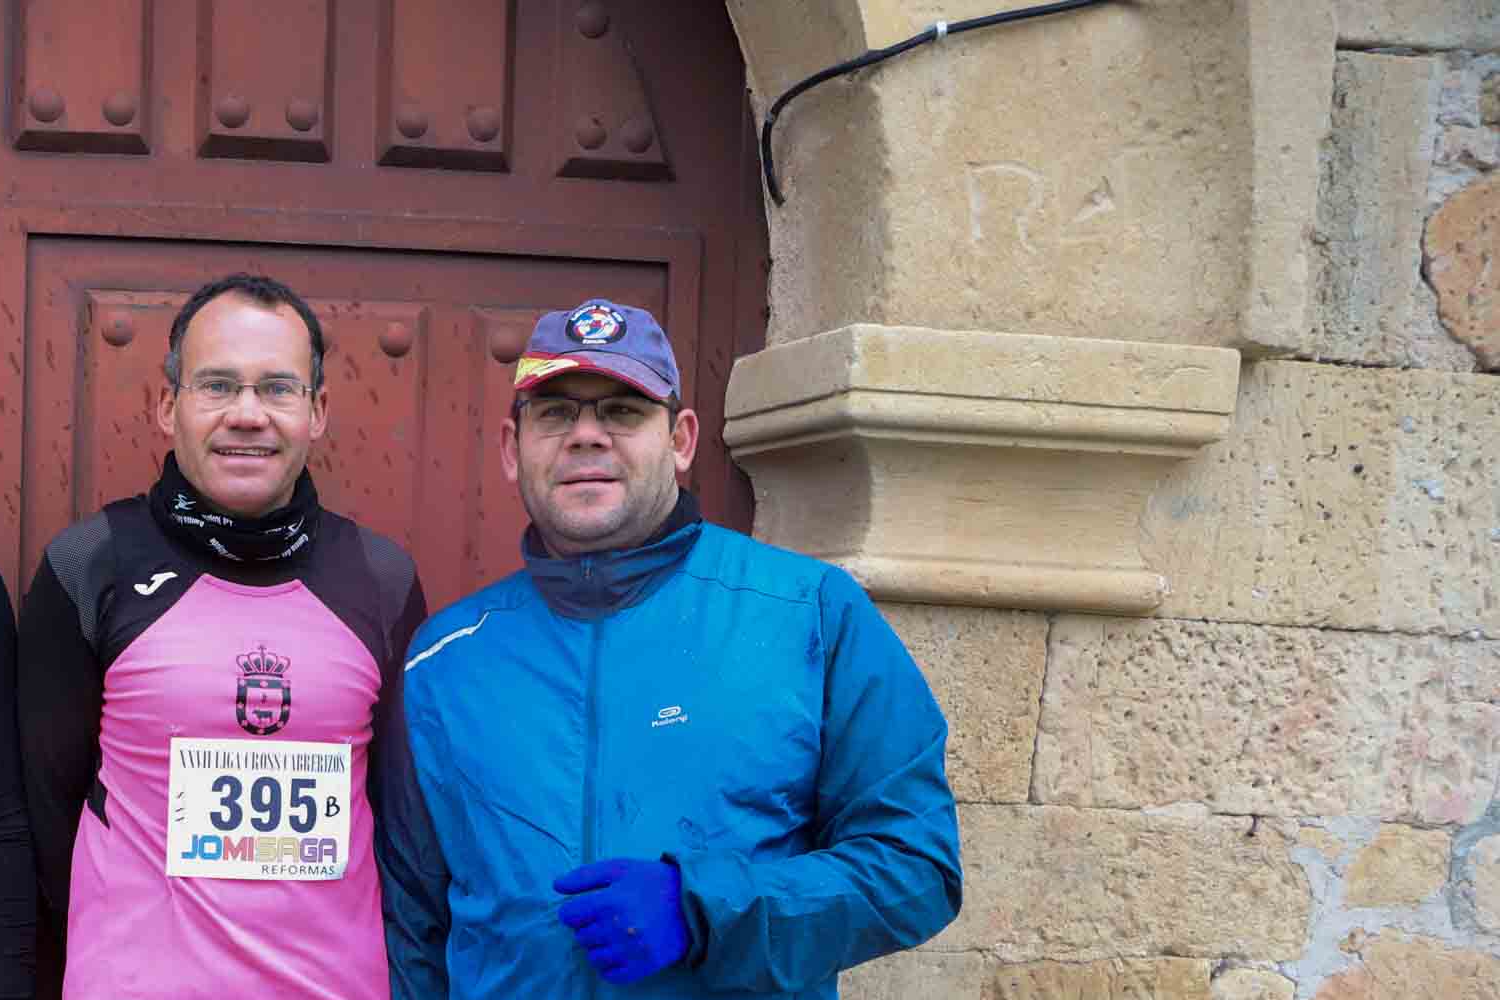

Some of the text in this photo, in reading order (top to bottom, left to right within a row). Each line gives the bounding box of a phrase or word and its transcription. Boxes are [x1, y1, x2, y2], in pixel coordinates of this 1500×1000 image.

[209, 775, 318, 833] 395
[324, 796, 341, 817] B
[261, 865, 335, 876] REFORMAS
